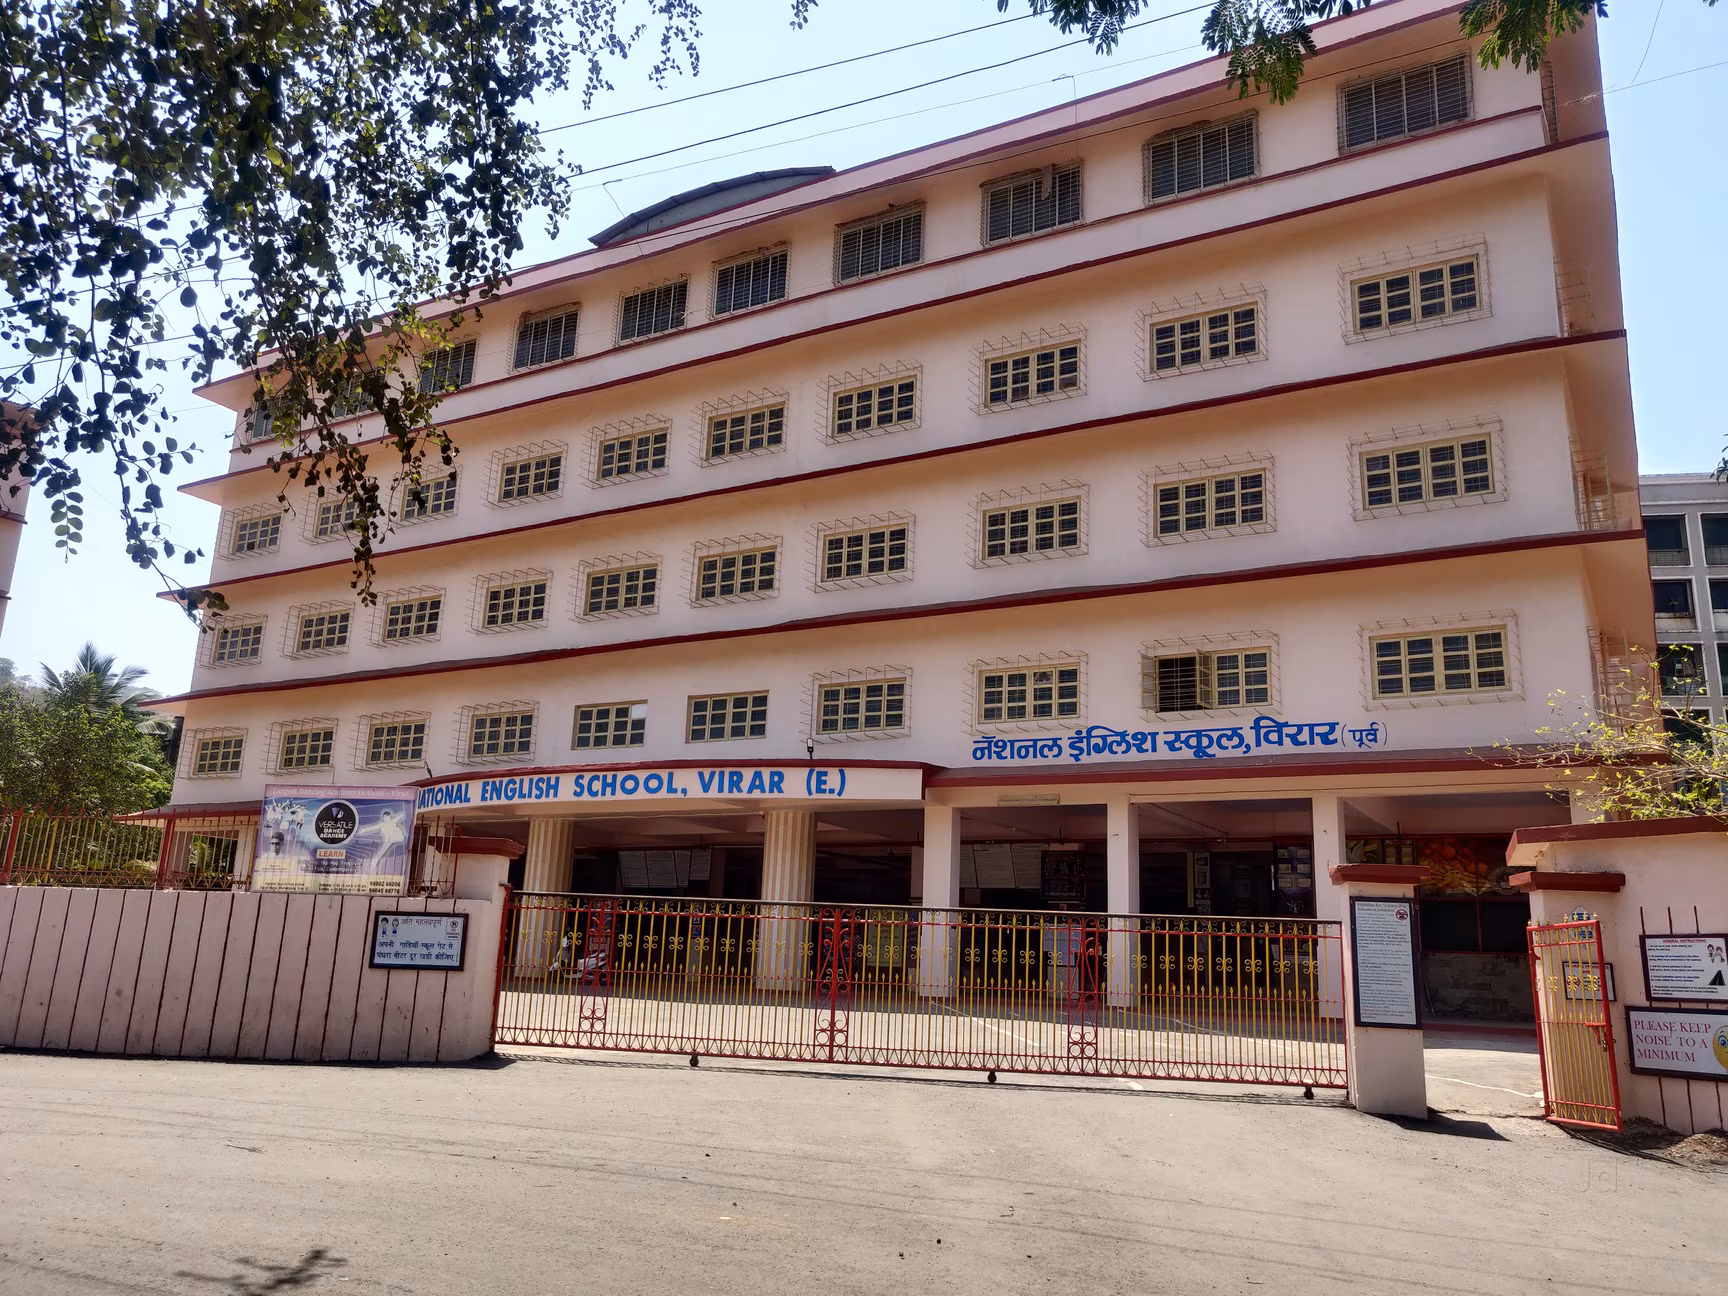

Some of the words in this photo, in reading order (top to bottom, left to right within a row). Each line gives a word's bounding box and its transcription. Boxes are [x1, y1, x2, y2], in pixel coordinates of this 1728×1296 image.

[1068, 725, 1159, 762] इंग्लिश
[1250, 715, 1340, 748] विरार
[480, 776, 560, 802] ENGLISH
[573, 771, 688, 797] SCHOOL,
[698, 770, 785, 794] VIRAR
[806, 768, 846, 797] (E.)
[299, 788, 325, 797] Dancing
[318, 820, 353, 829] VERSATILE
[1634, 1020, 1677, 1032] PLEASE
[1680, 1022, 1711, 1034] KEEP
[1635, 1034, 1671, 1046] NOISE
[1676, 1036, 1696, 1047] TO
[1699, 1038, 1708, 1048] A
[1637, 1048, 1696, 1062] MINIMUM
